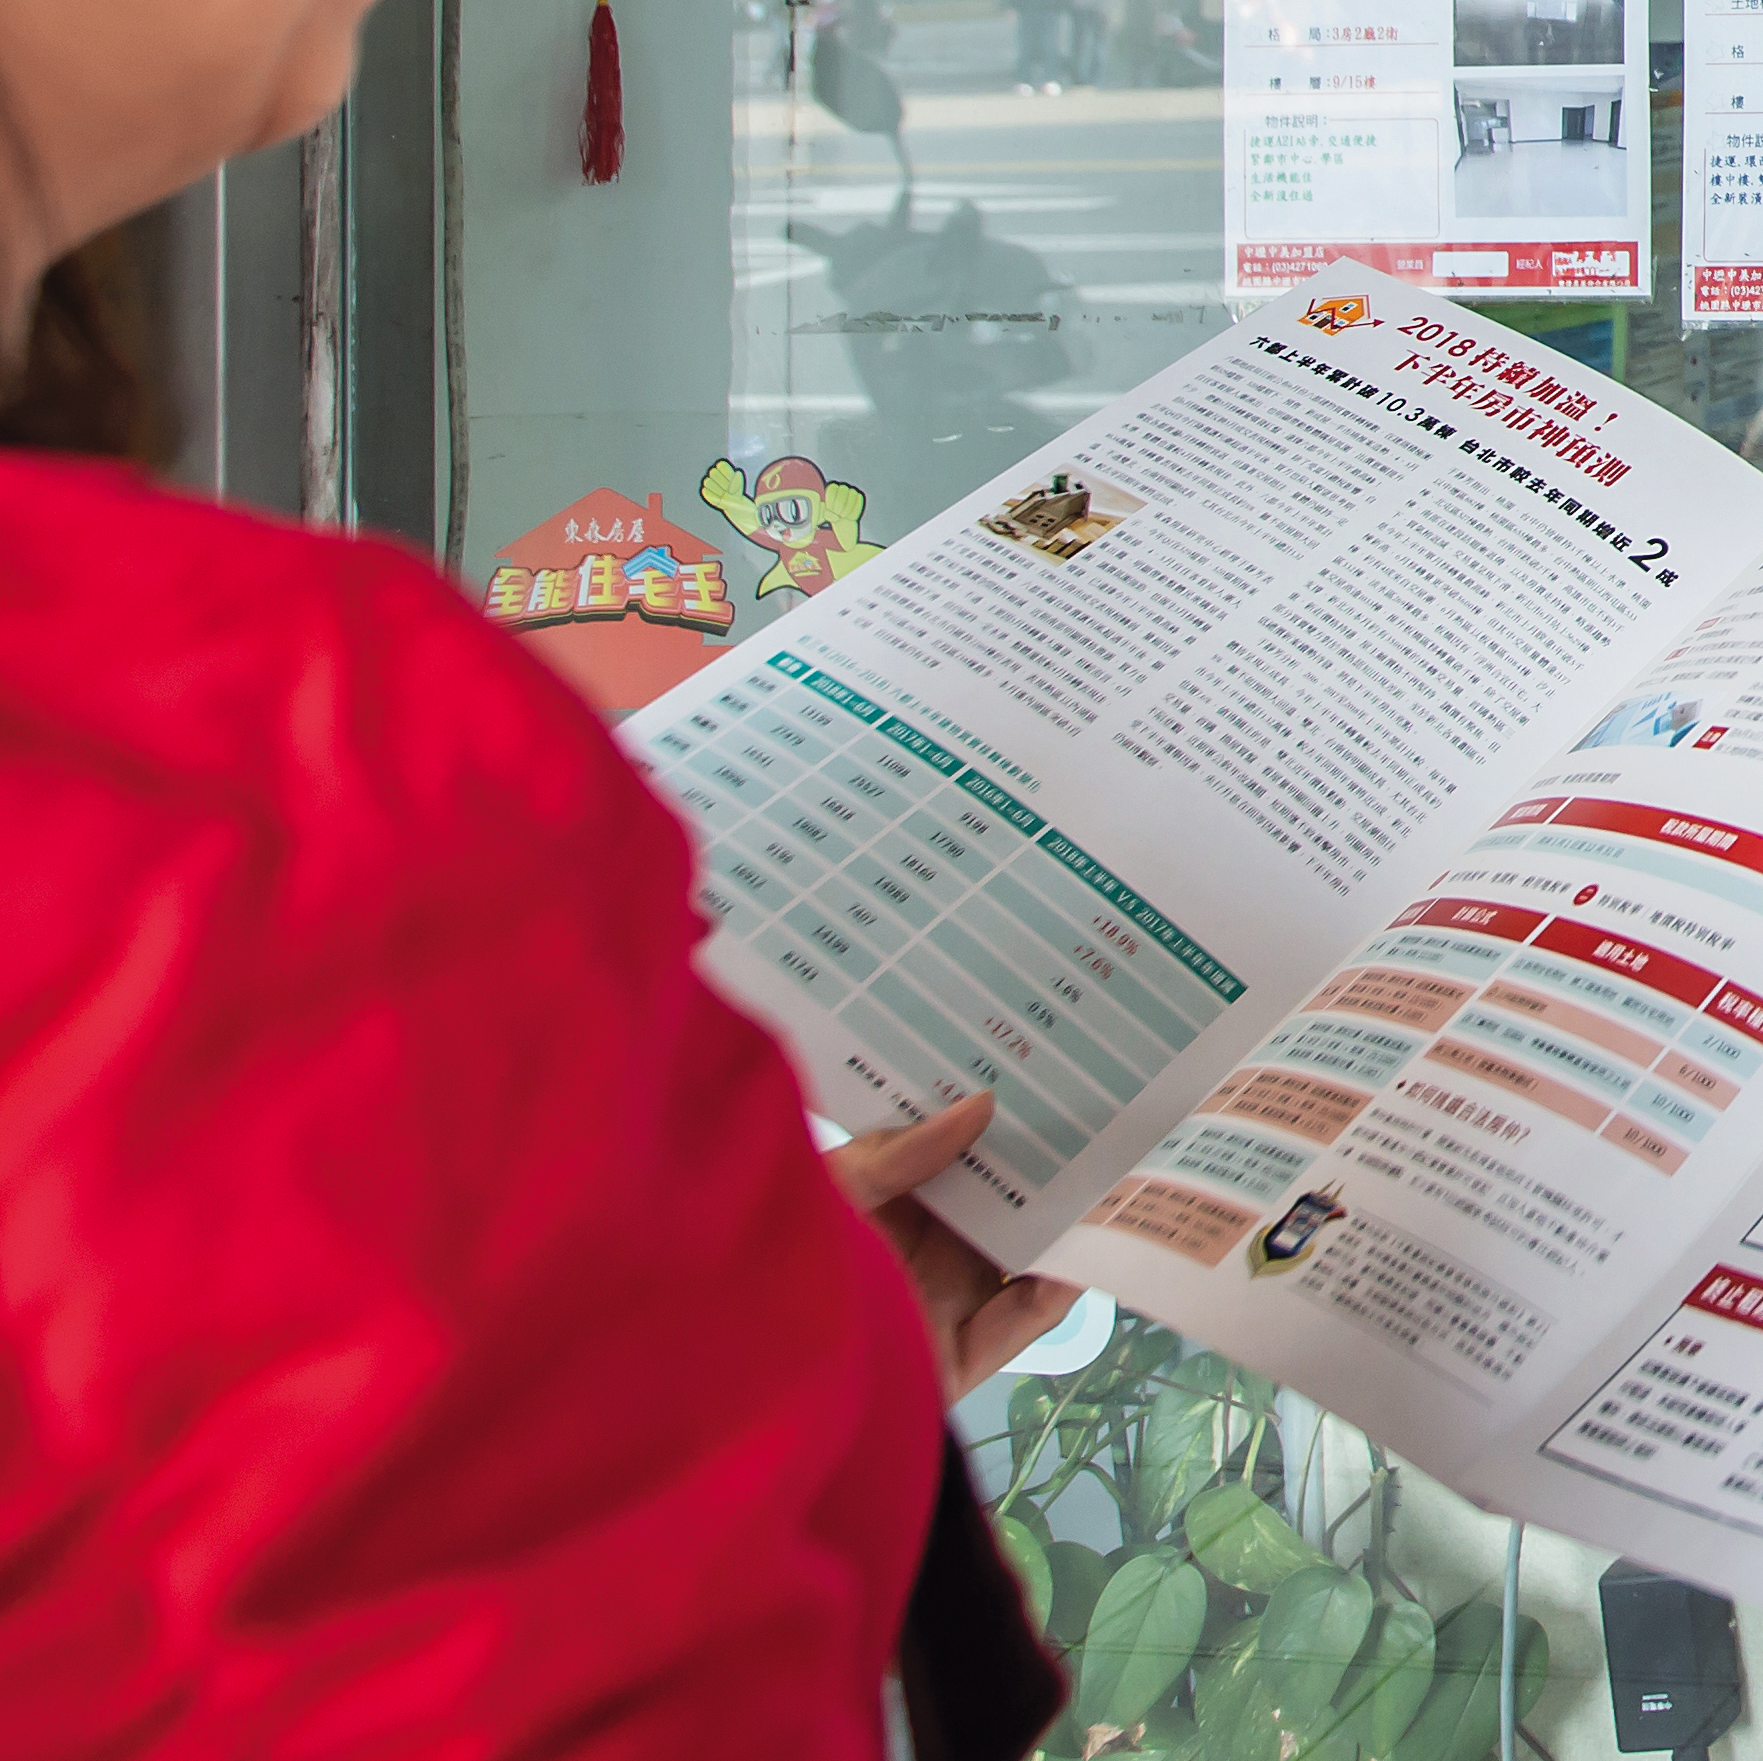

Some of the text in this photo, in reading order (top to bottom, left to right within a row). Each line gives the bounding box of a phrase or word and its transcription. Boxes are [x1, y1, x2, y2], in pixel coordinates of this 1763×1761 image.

[1393, 348, 1632, 490] 下半年房市神預測
[1396, 314, 1621, 433] 2018持續加溫！
[564, 517, 645, 544] 東森房屋
[487, 546, 733, 617] 全能住宅王
